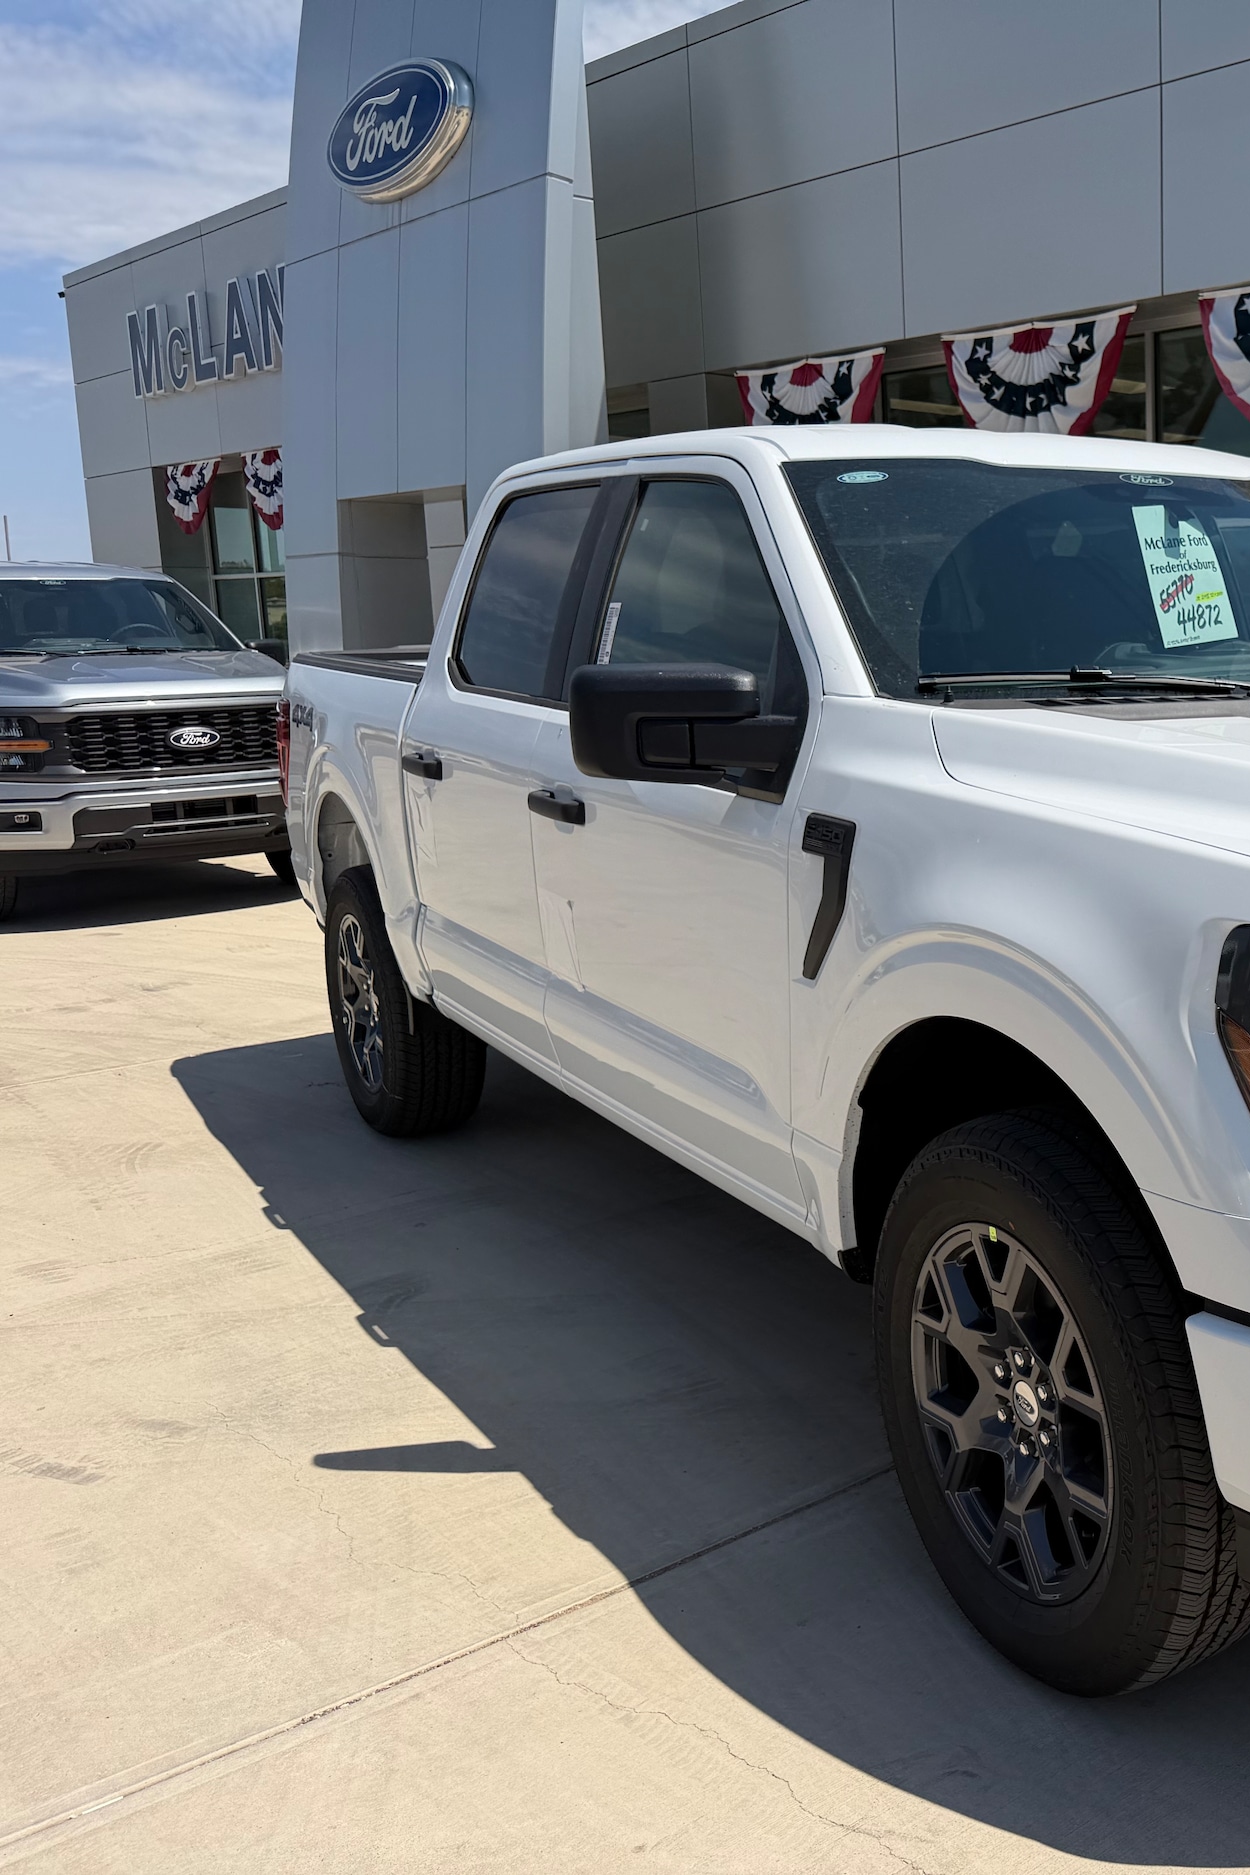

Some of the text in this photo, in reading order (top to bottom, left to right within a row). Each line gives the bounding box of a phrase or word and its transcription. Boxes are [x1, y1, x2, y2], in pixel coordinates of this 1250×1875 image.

[346, 88, 418, 171] Ford
[1144, 534, 1208, 551] McLane Ford
[1179, 550, 1187, 559] of
[1150, 559, 1218, 575] Fredericksburg
[1177, 604, 1223, 636] 44872
[180, 732, 210, 744] Ford
